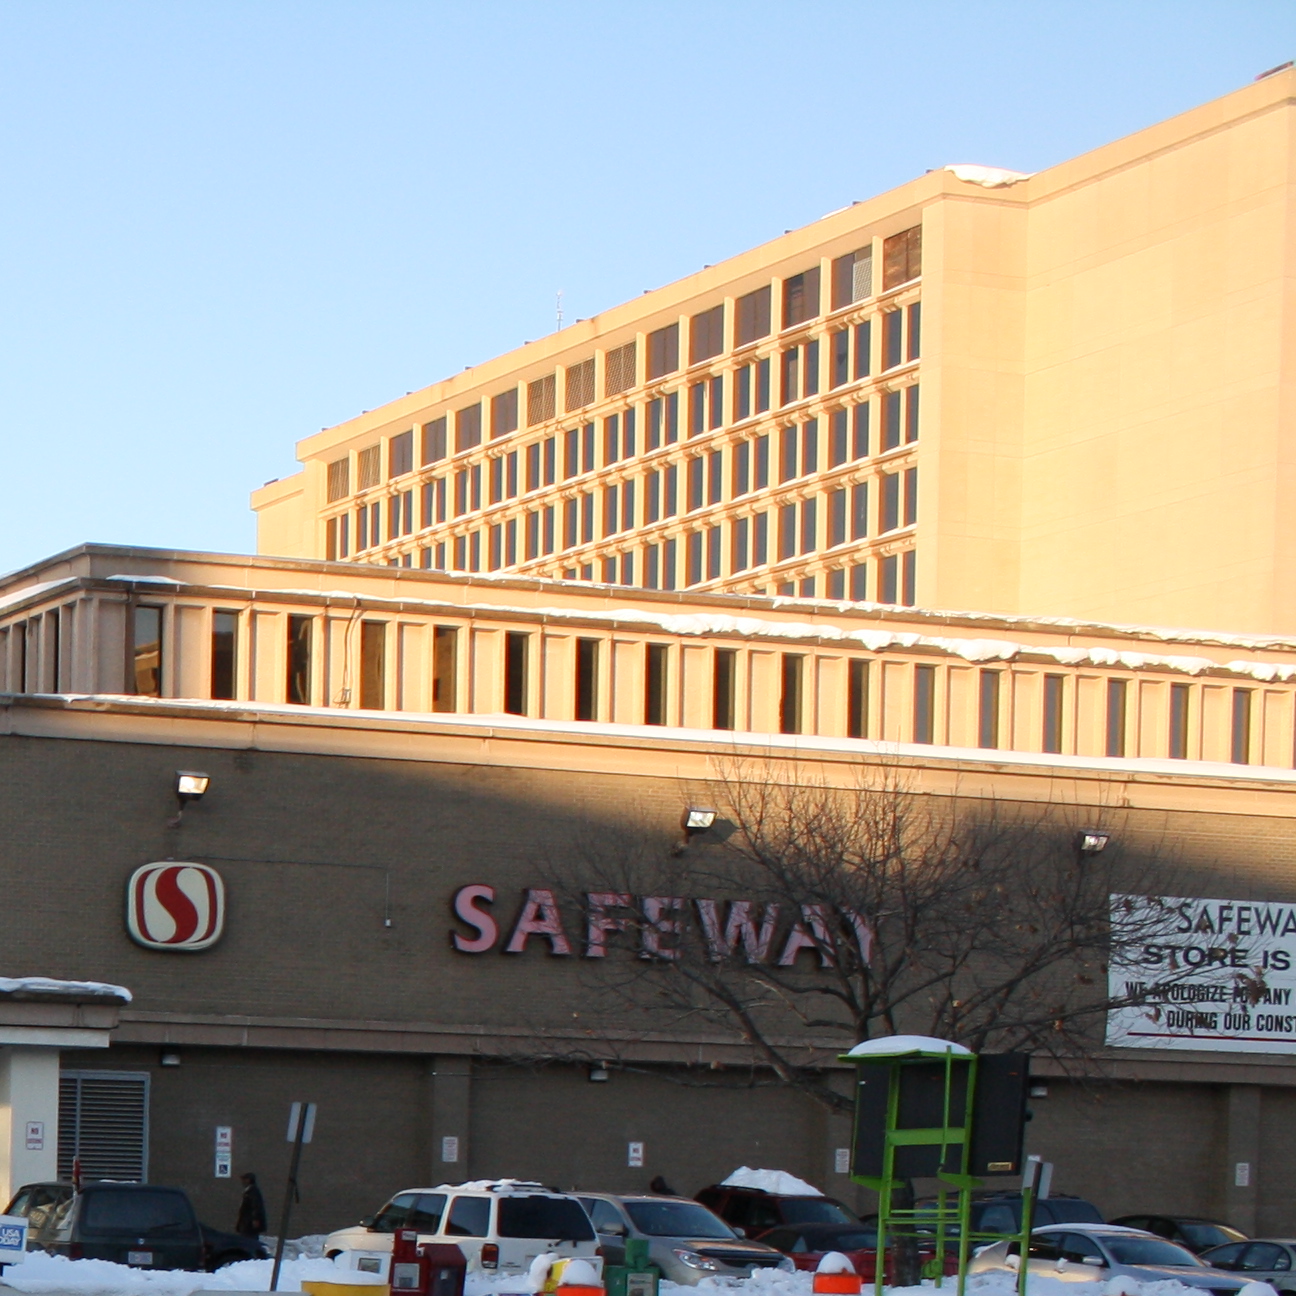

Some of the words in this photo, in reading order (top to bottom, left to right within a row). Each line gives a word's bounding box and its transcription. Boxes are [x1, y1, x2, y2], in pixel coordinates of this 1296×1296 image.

[450, 883, 877, 968] SAFEWAY
[1143, 944, 1250, 968] STORE
[1262, 950, 1291, 971] IS
[1264, 987, 1292, 1006] ANY
[1223, 1012, 1251, 1031] OUR
[1, 1228, 20, 1237] USA
